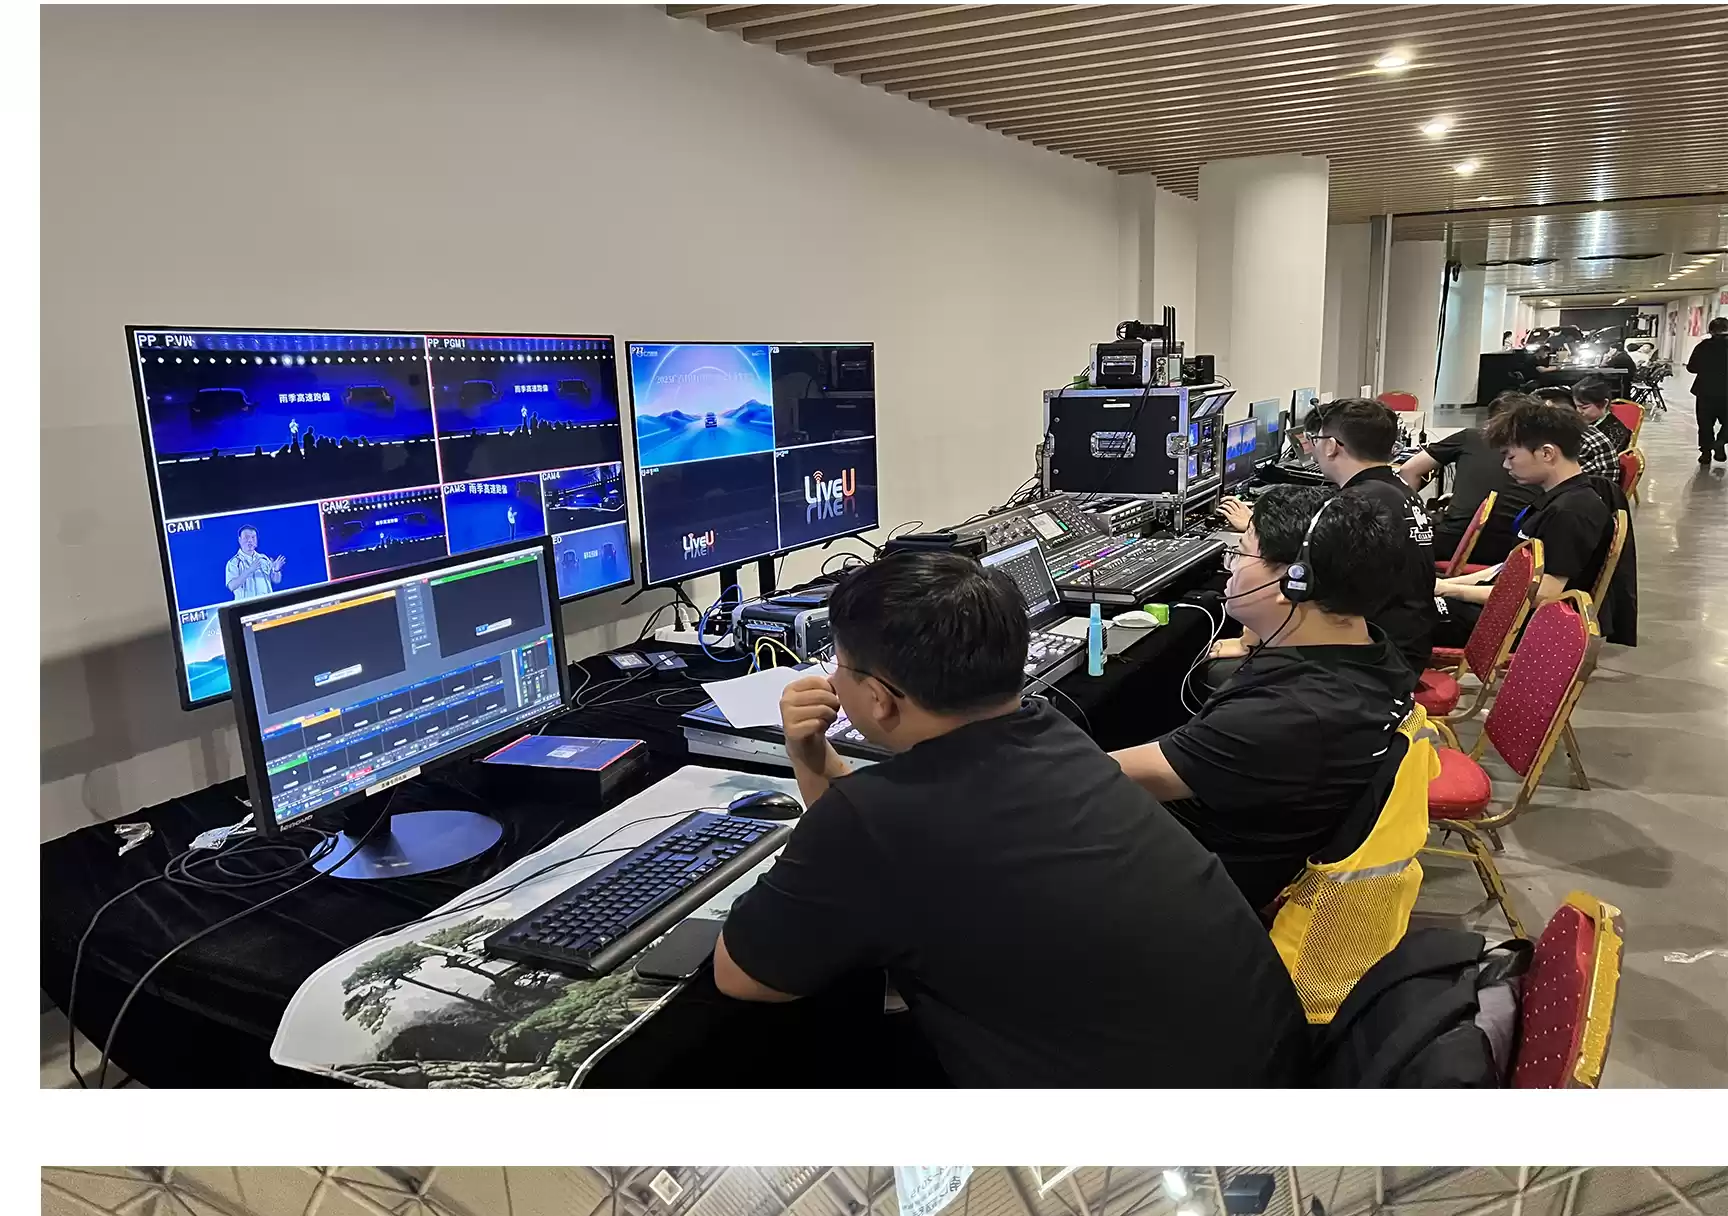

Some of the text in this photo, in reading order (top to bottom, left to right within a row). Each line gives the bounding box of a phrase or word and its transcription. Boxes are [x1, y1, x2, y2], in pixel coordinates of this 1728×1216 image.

[542, 471, 561, 481] CAM4
[444, 484, 466, 495] CAM3
[322, 500, 350, 512] CAM2
[166, 519, 202, 534] CAM1
